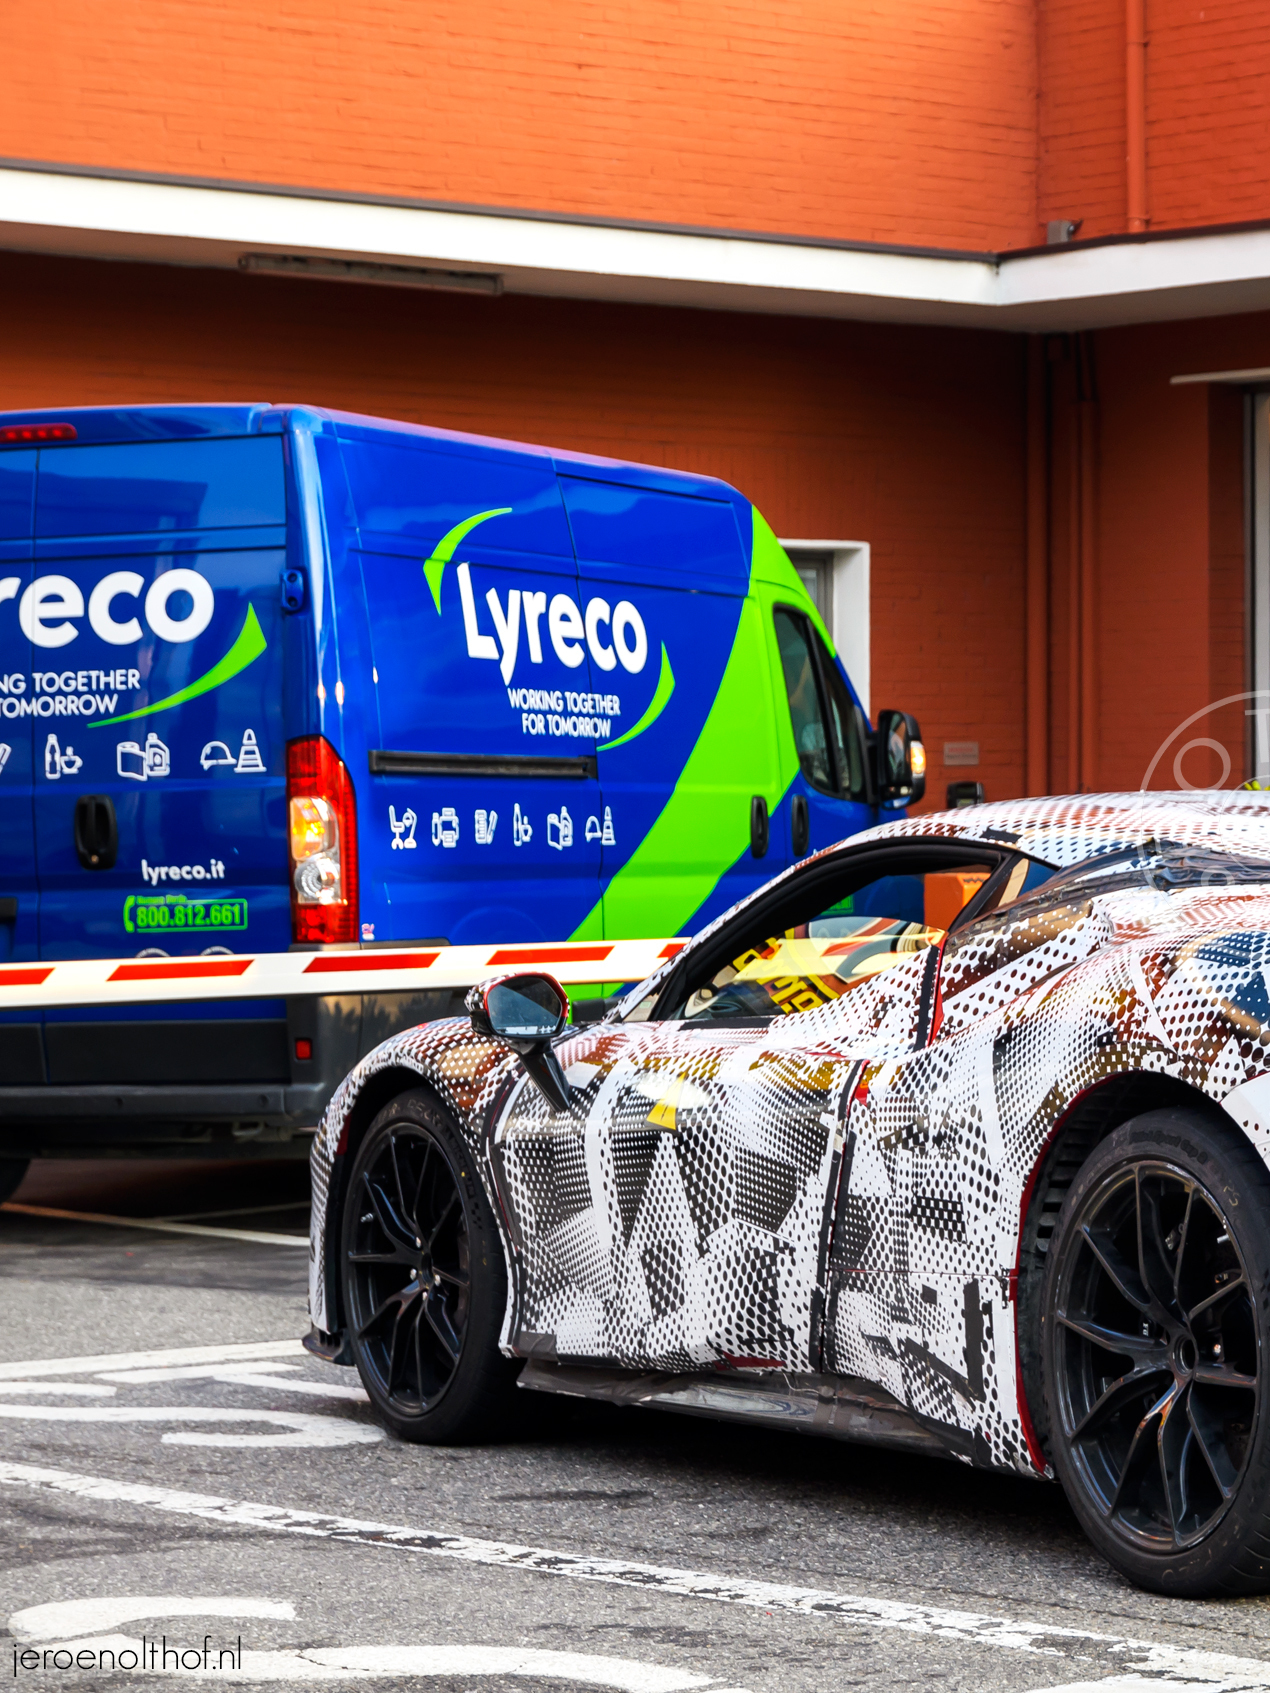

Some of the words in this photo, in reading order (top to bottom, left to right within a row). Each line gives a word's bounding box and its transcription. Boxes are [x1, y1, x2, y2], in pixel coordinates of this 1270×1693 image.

[457, 562, 648, 686] Lyreco
[32, 669, 140, 693] TOGETHER
[507, 687, 563, 713] WORKING
[565, 691, 621, 716] TOGETHER
[522, 713, 545, 735] FOR
[546, 714, 611, 738] TOMORROW
[141, 858, 225, 886] lyreco.it
[136, 904, 241, 927] 800.812.661
